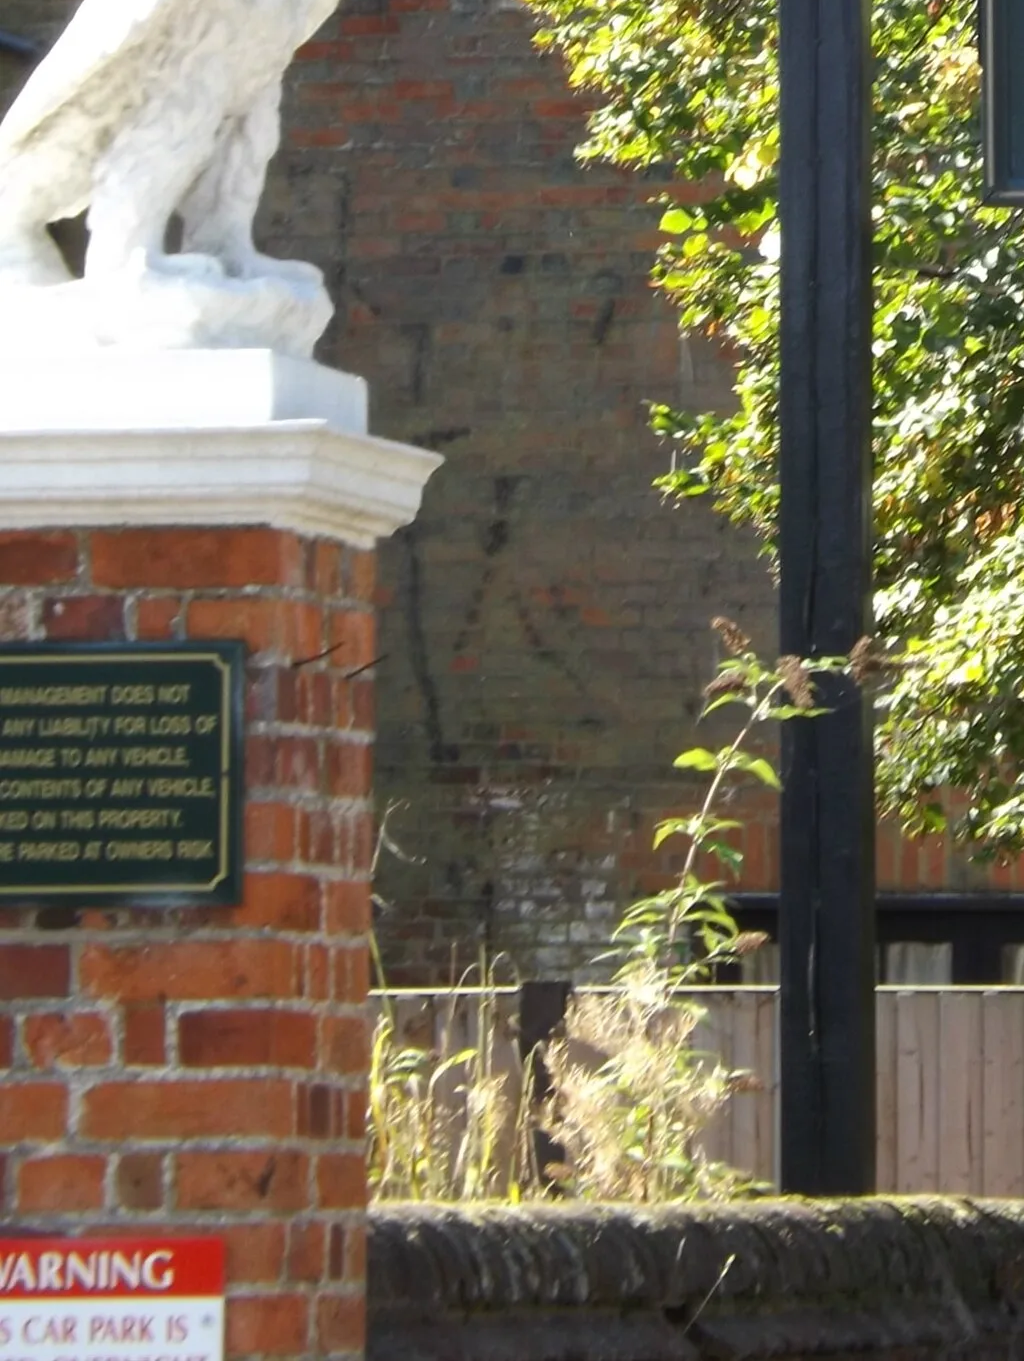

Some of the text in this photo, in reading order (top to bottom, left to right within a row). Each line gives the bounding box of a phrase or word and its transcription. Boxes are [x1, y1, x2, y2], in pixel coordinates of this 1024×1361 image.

[111, 684, 154, 705] DOES
[158, 684, 190, 704] NOT
[2, 715, 217, 742] ANY LIABILITY FOR LOSS OF
[61, 748, 80, 767] TO
[84, 747, 118, 767] ANY
[0, 779, 81, 799] CONTENTS
[86, 779, 107, 798] OF
[110, 779, 143, 798] ANY
[32, 811, 56, 830] ON
[61, 810, 94, 830] THIS
[19, 842, 80, 862] PARKED
[83, 842, 102, 861] AT
[21, 1315, 78, 1345] CAR
[87, 1314, 155, 1344] PARK
[166, 1313, 189, 1343] IS
